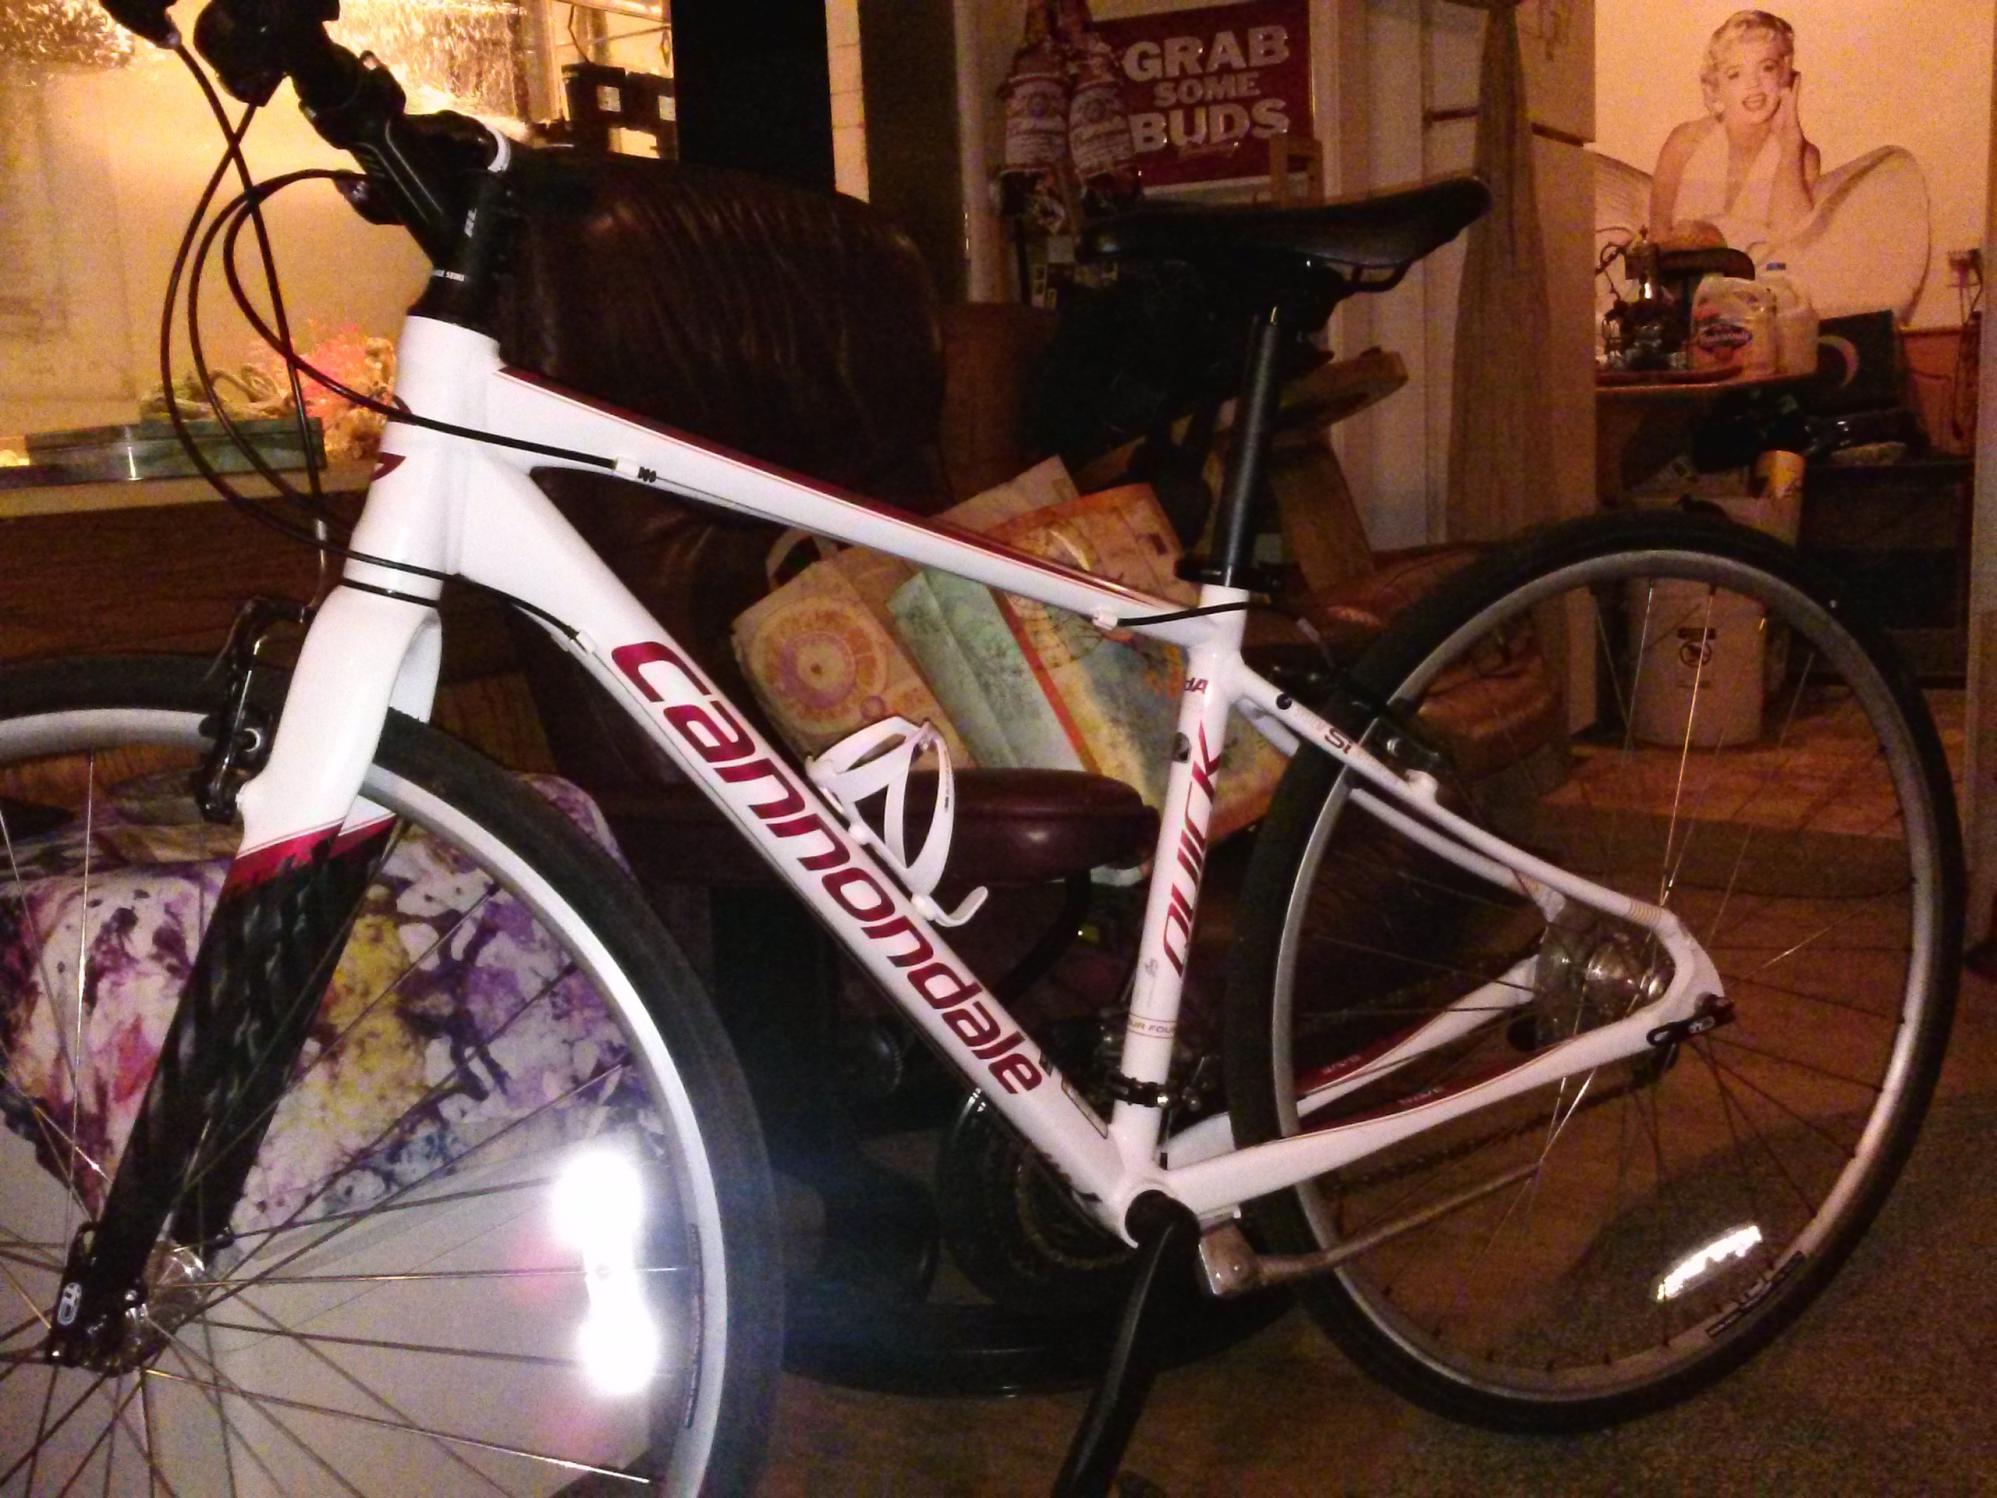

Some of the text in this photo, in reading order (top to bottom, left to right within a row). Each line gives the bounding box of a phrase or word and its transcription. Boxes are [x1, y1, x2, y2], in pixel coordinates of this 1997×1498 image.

[1122, 25, 1290, 82] GRAB
[1153, 72, 1261, 107] SOME
[1128, 98, 1291, 154] BUDS
[611, 640, 1043, 1095] cannondale
